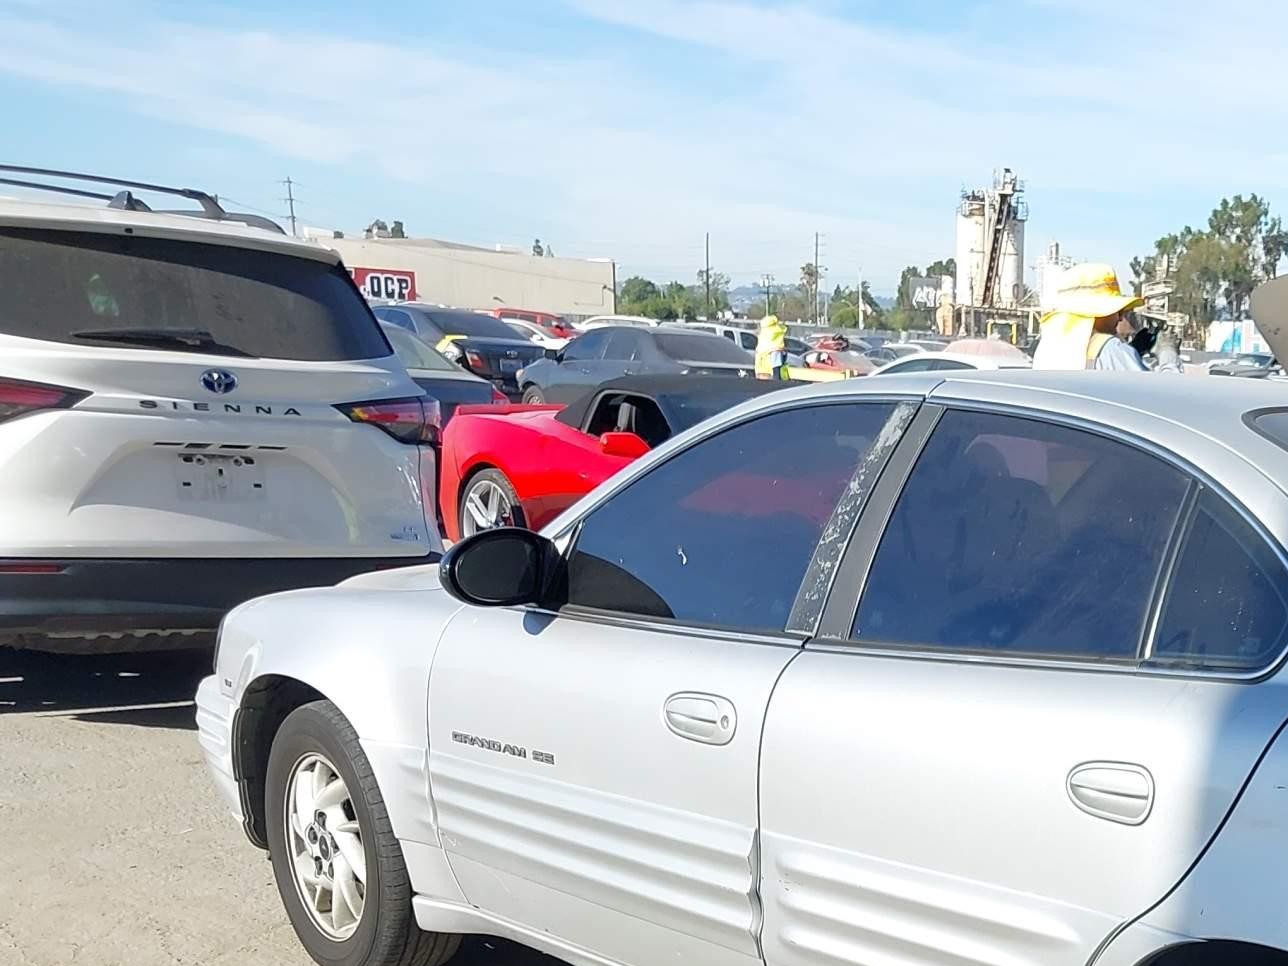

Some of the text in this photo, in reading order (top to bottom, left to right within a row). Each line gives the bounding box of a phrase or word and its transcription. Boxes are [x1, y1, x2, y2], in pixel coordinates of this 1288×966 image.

[139, 400, 301, 416] SIENNA
[452, 731, 501, 752] GRAND
[503, 744, 526, 758] AM
